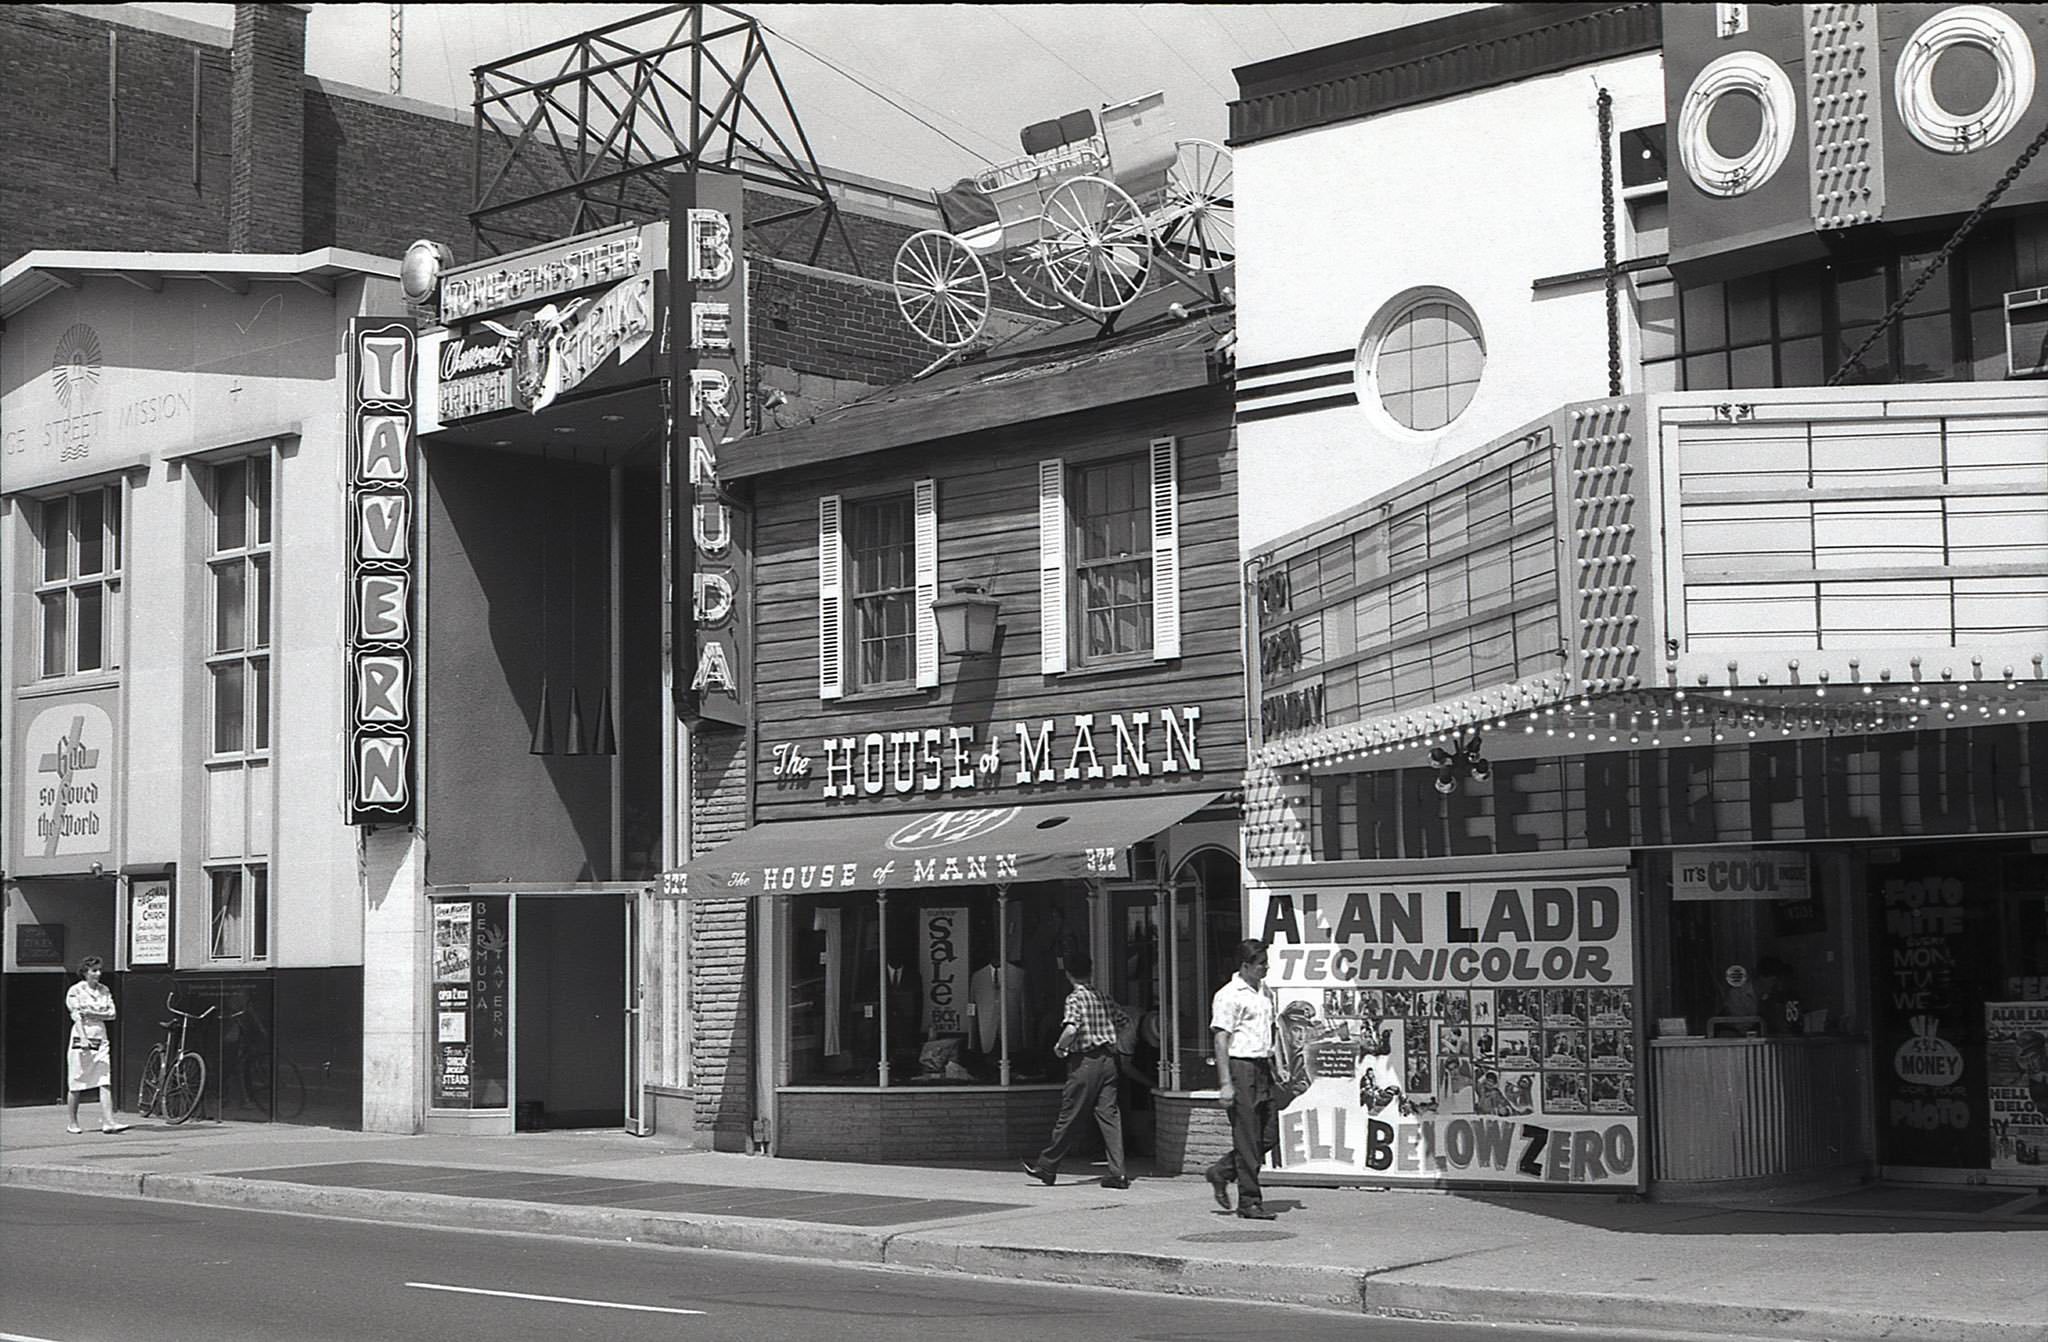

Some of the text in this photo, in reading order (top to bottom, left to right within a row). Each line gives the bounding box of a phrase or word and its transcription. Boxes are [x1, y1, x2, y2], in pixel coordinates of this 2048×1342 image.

[43, 410, 103, 446] STREET
[121, 390, 192, 428] MISSION
[363, 342, 404, 799] TAVERN
[773, 705, 1201, 798] The HOUSE of MANN
[728, 853, 1018, 891] The HOUSE of MANN
[1682, 867, 1707, 882] IT'S
[1709, 860, 1778, 892] COOL
[1260, 884, 1620, 945] ALAN LADD
[476, 902, 488, 1009] BERMUDA
[1279, 945, 1613, 983] TECHNICOLOR
[494, 950, 504, 1038] TAVERN
[1901, 1055, 1959, 1076] MONEY
[1990, 1088, 2028, 1099] HELL
[1362, 1118, 1512, 1173] BELOW
[1519, 1123, 1632, 1185] ZERO
